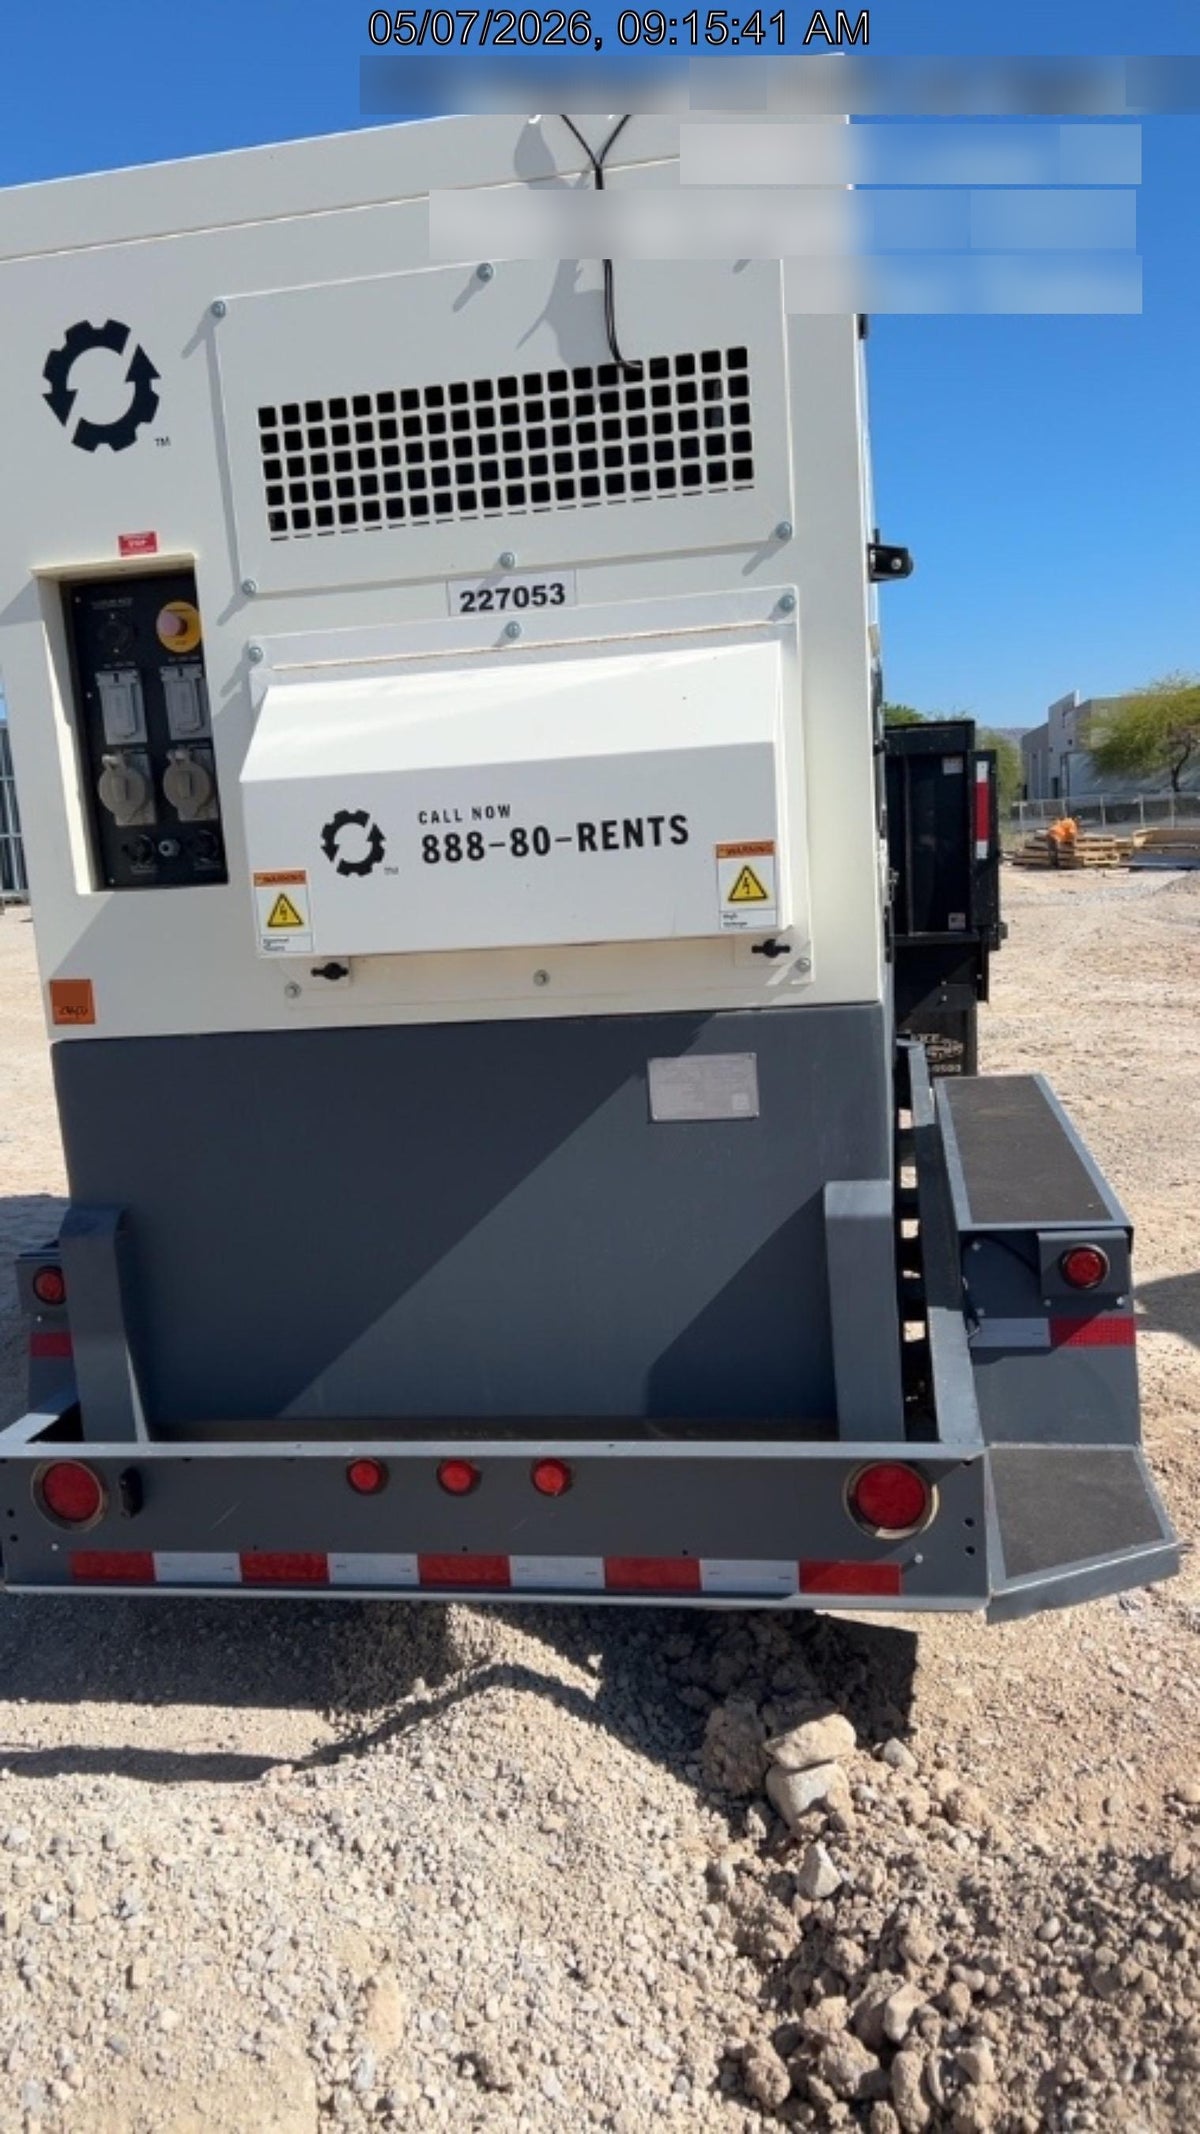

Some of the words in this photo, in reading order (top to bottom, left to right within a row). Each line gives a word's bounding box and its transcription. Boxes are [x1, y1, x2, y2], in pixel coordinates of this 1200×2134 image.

[460, 582, 565, 613] 227053
[418, 808, 463, 824] CALL
[472, 804, 511, 821] NOW
[421, 814, 690, 864] 888-80-RENTS
